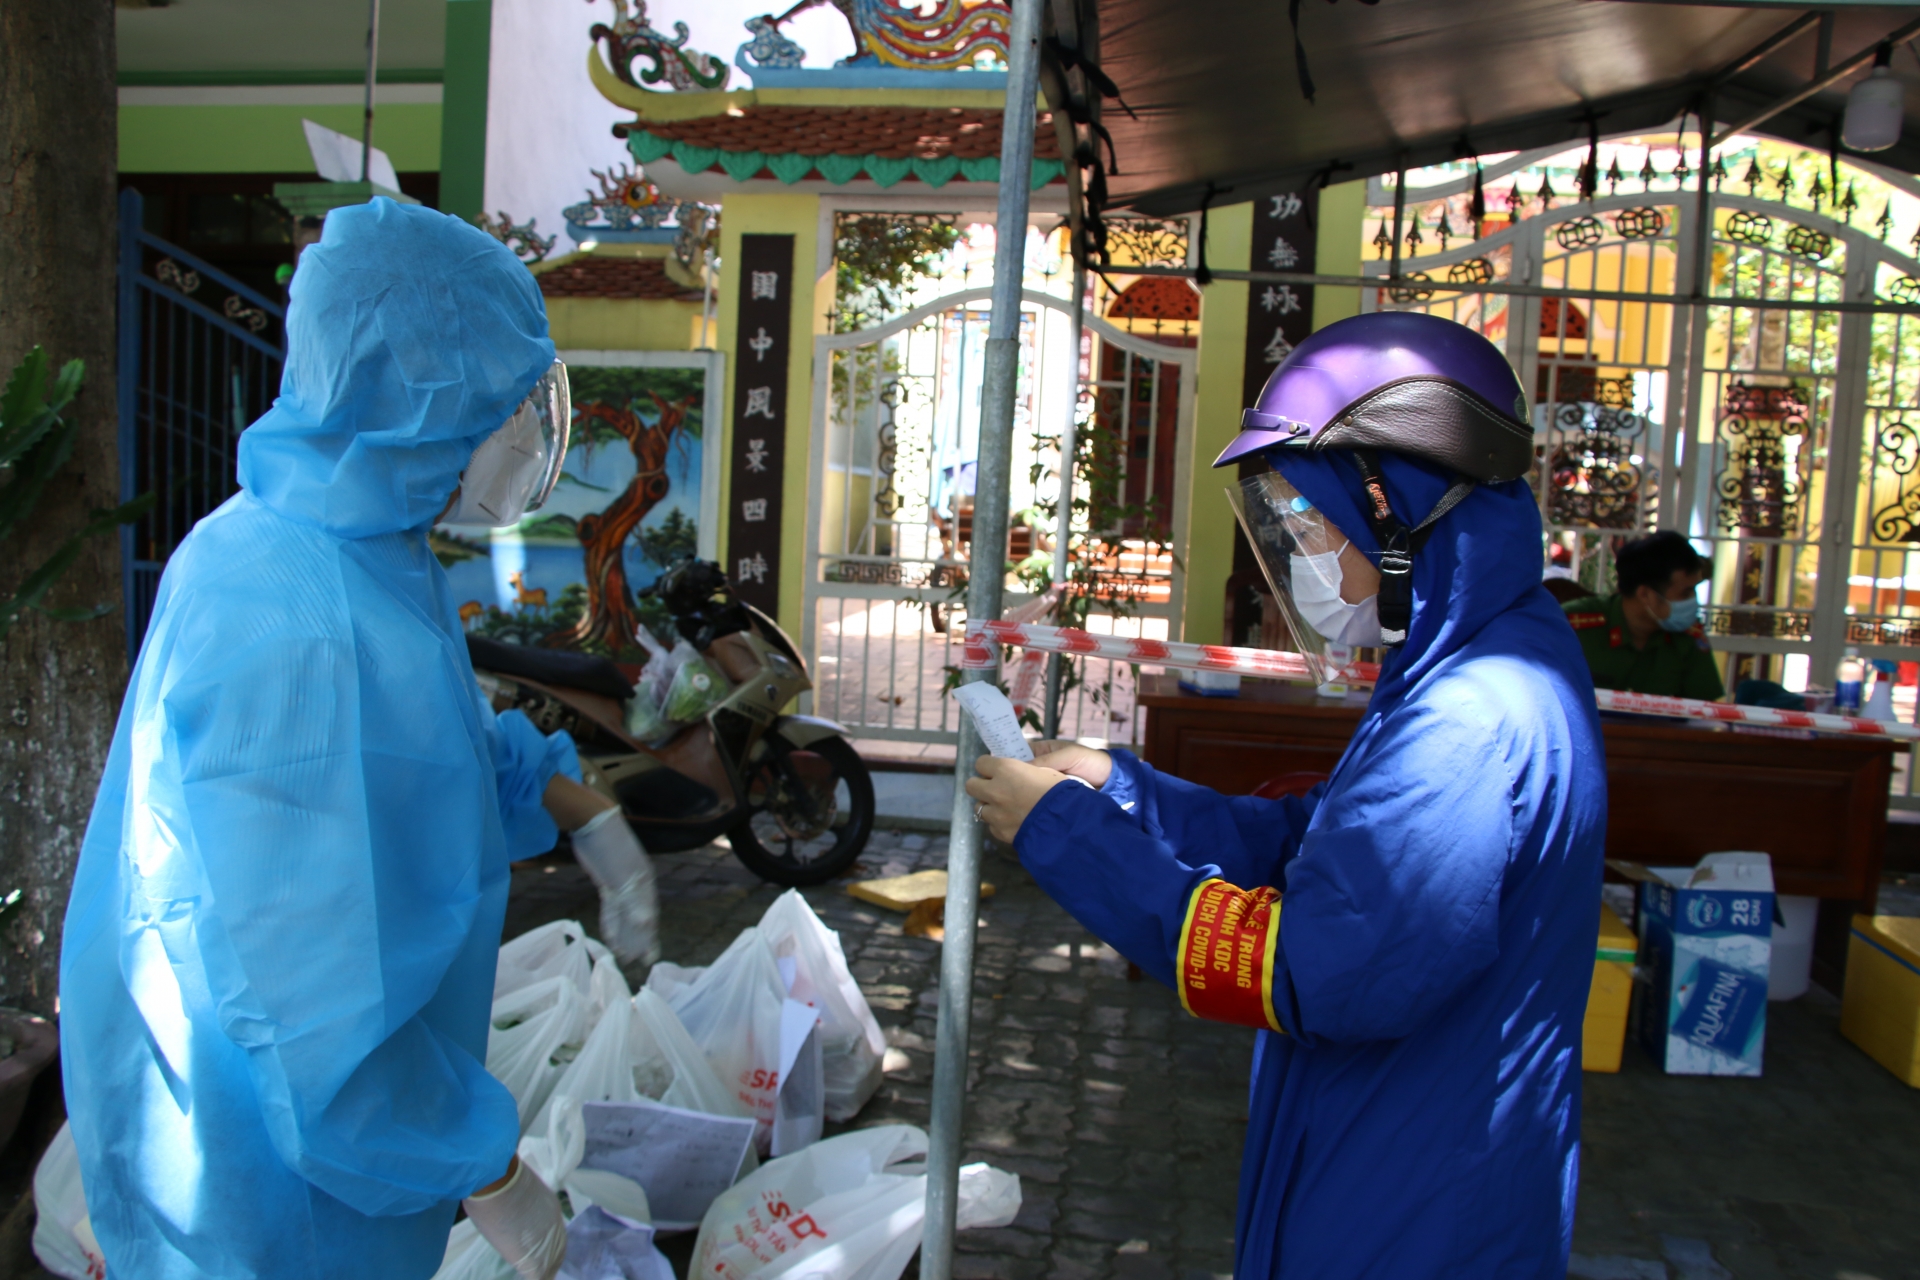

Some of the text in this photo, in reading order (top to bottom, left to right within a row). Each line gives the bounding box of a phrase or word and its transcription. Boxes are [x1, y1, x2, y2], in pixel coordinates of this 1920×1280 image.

[1189, 890, 1225, 990] DỊCH COVID-19
[1731, 899, 1750, 927] 28
[1213, 939, 1233, 973] KDC
[1237, 933, 1257, 989] TRUNG
[1688, 970, 1746, 1047] AQUAFINA
